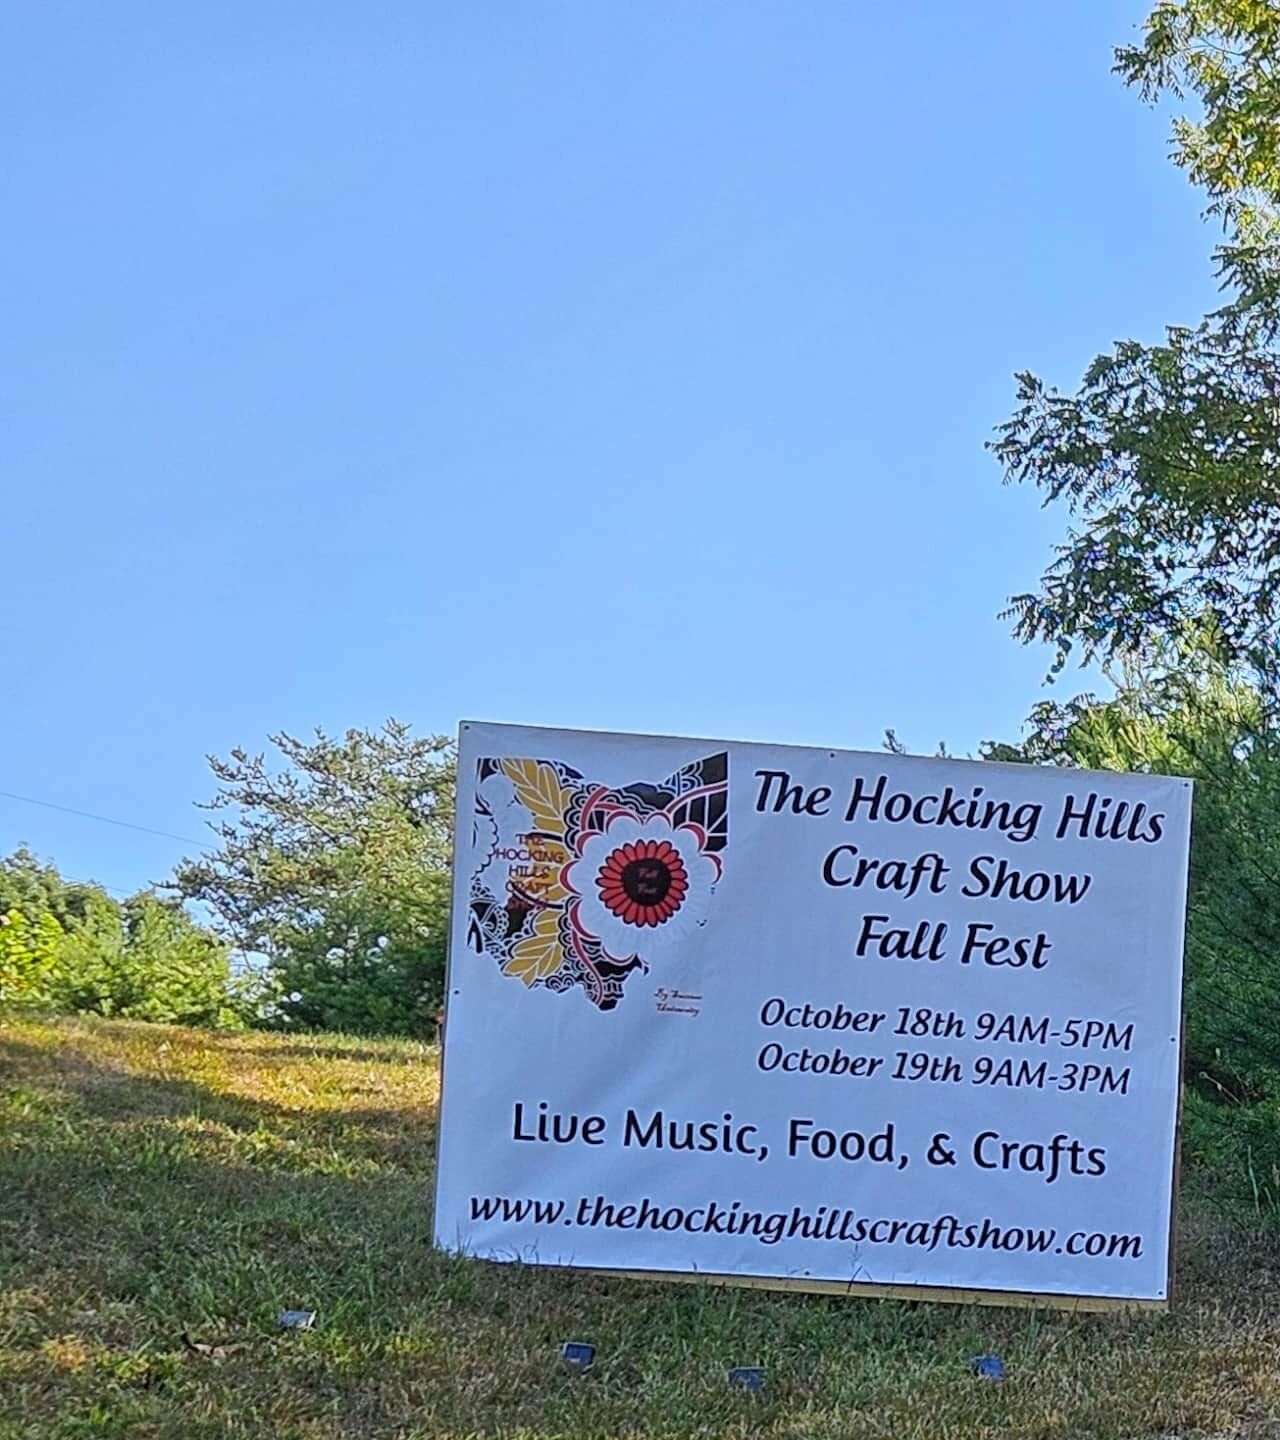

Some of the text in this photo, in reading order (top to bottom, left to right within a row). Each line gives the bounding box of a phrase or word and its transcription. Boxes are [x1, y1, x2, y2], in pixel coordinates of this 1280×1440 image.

[755, 770, 1165, 842] The Hocking Hills
[495, 848, 564, 863] HOCKING
[822, 844, 1092, 904] Craft Show
[855, 915, 1052, 969] Fall Fest
[760, 998, 1134, 1051] October 18th 9AM-5PM
[758, 1043, 1131, 1095] October 19th 9AM-3PM
[513, 1102, 1106, 1183] Live Music, Food, & Crafts
[470, 1195, 1144, 1259] www.thehockinghillscraftshow.com
